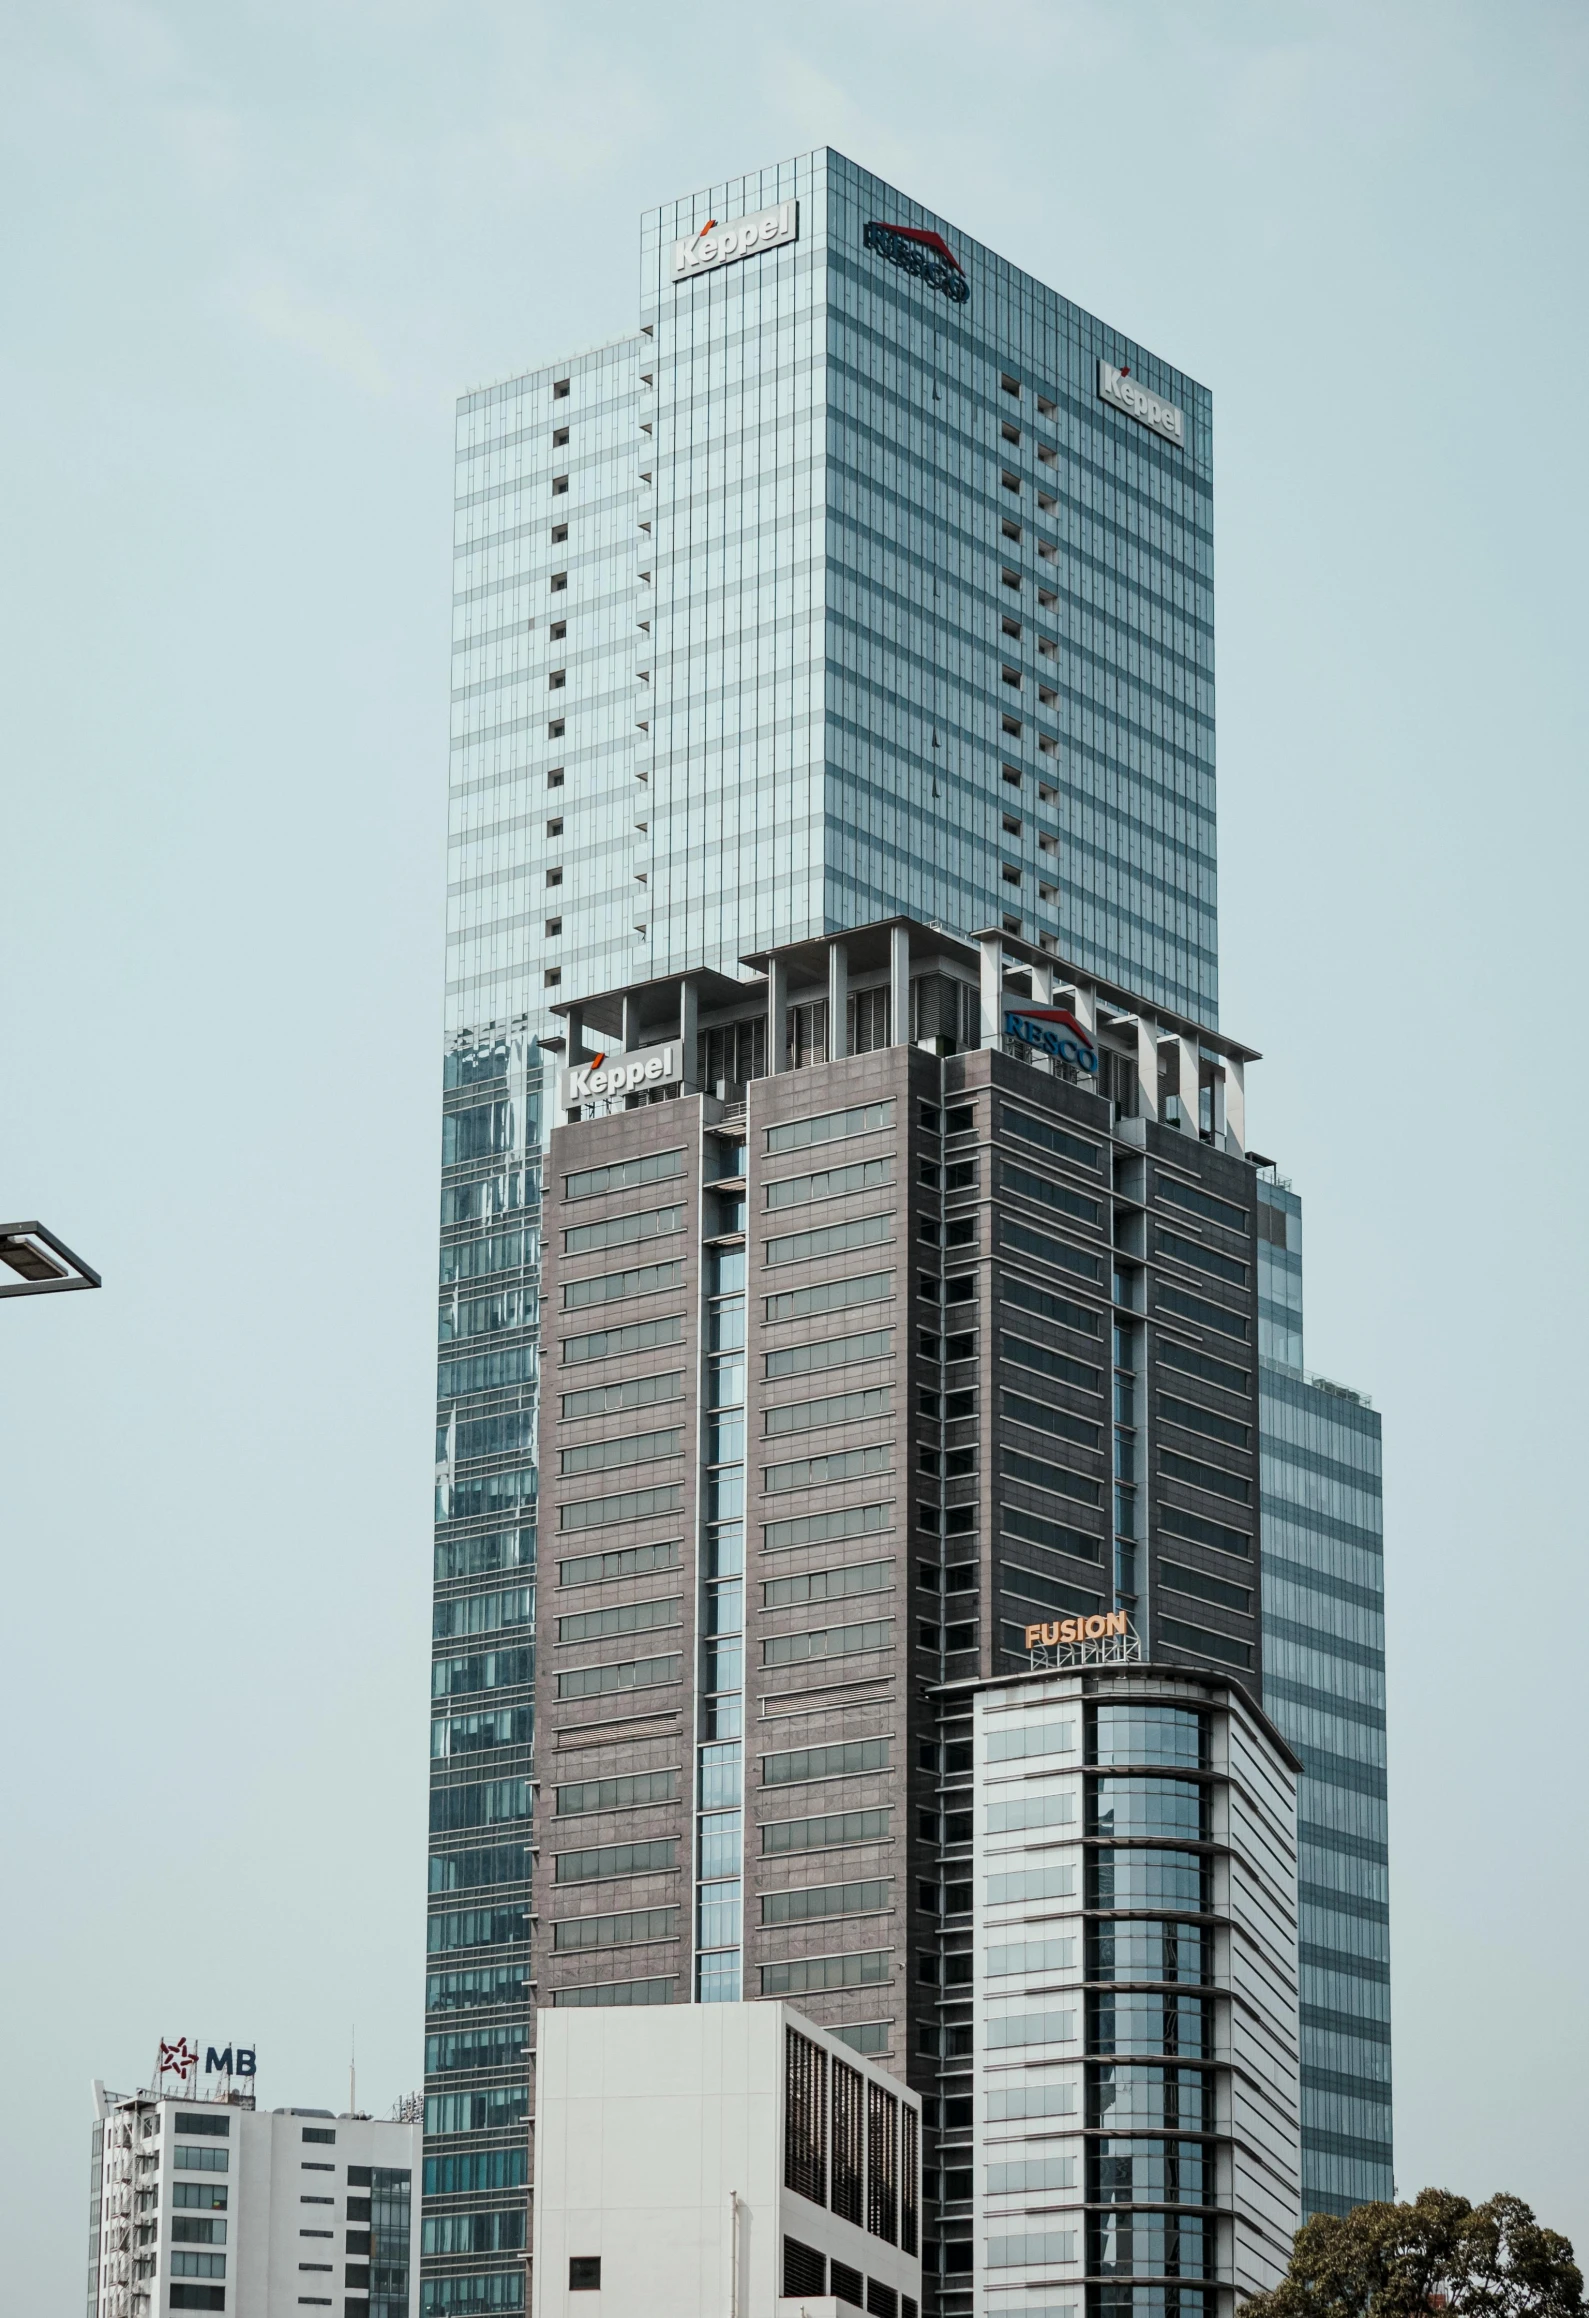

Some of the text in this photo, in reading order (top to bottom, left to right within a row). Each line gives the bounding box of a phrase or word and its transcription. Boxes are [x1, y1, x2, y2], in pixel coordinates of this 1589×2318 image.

[1005, 1011, 1098, 1073] RESCO
[1025, 1610, 1127, 1650] FUSION
[205, 2046, 257, 2076] MB
